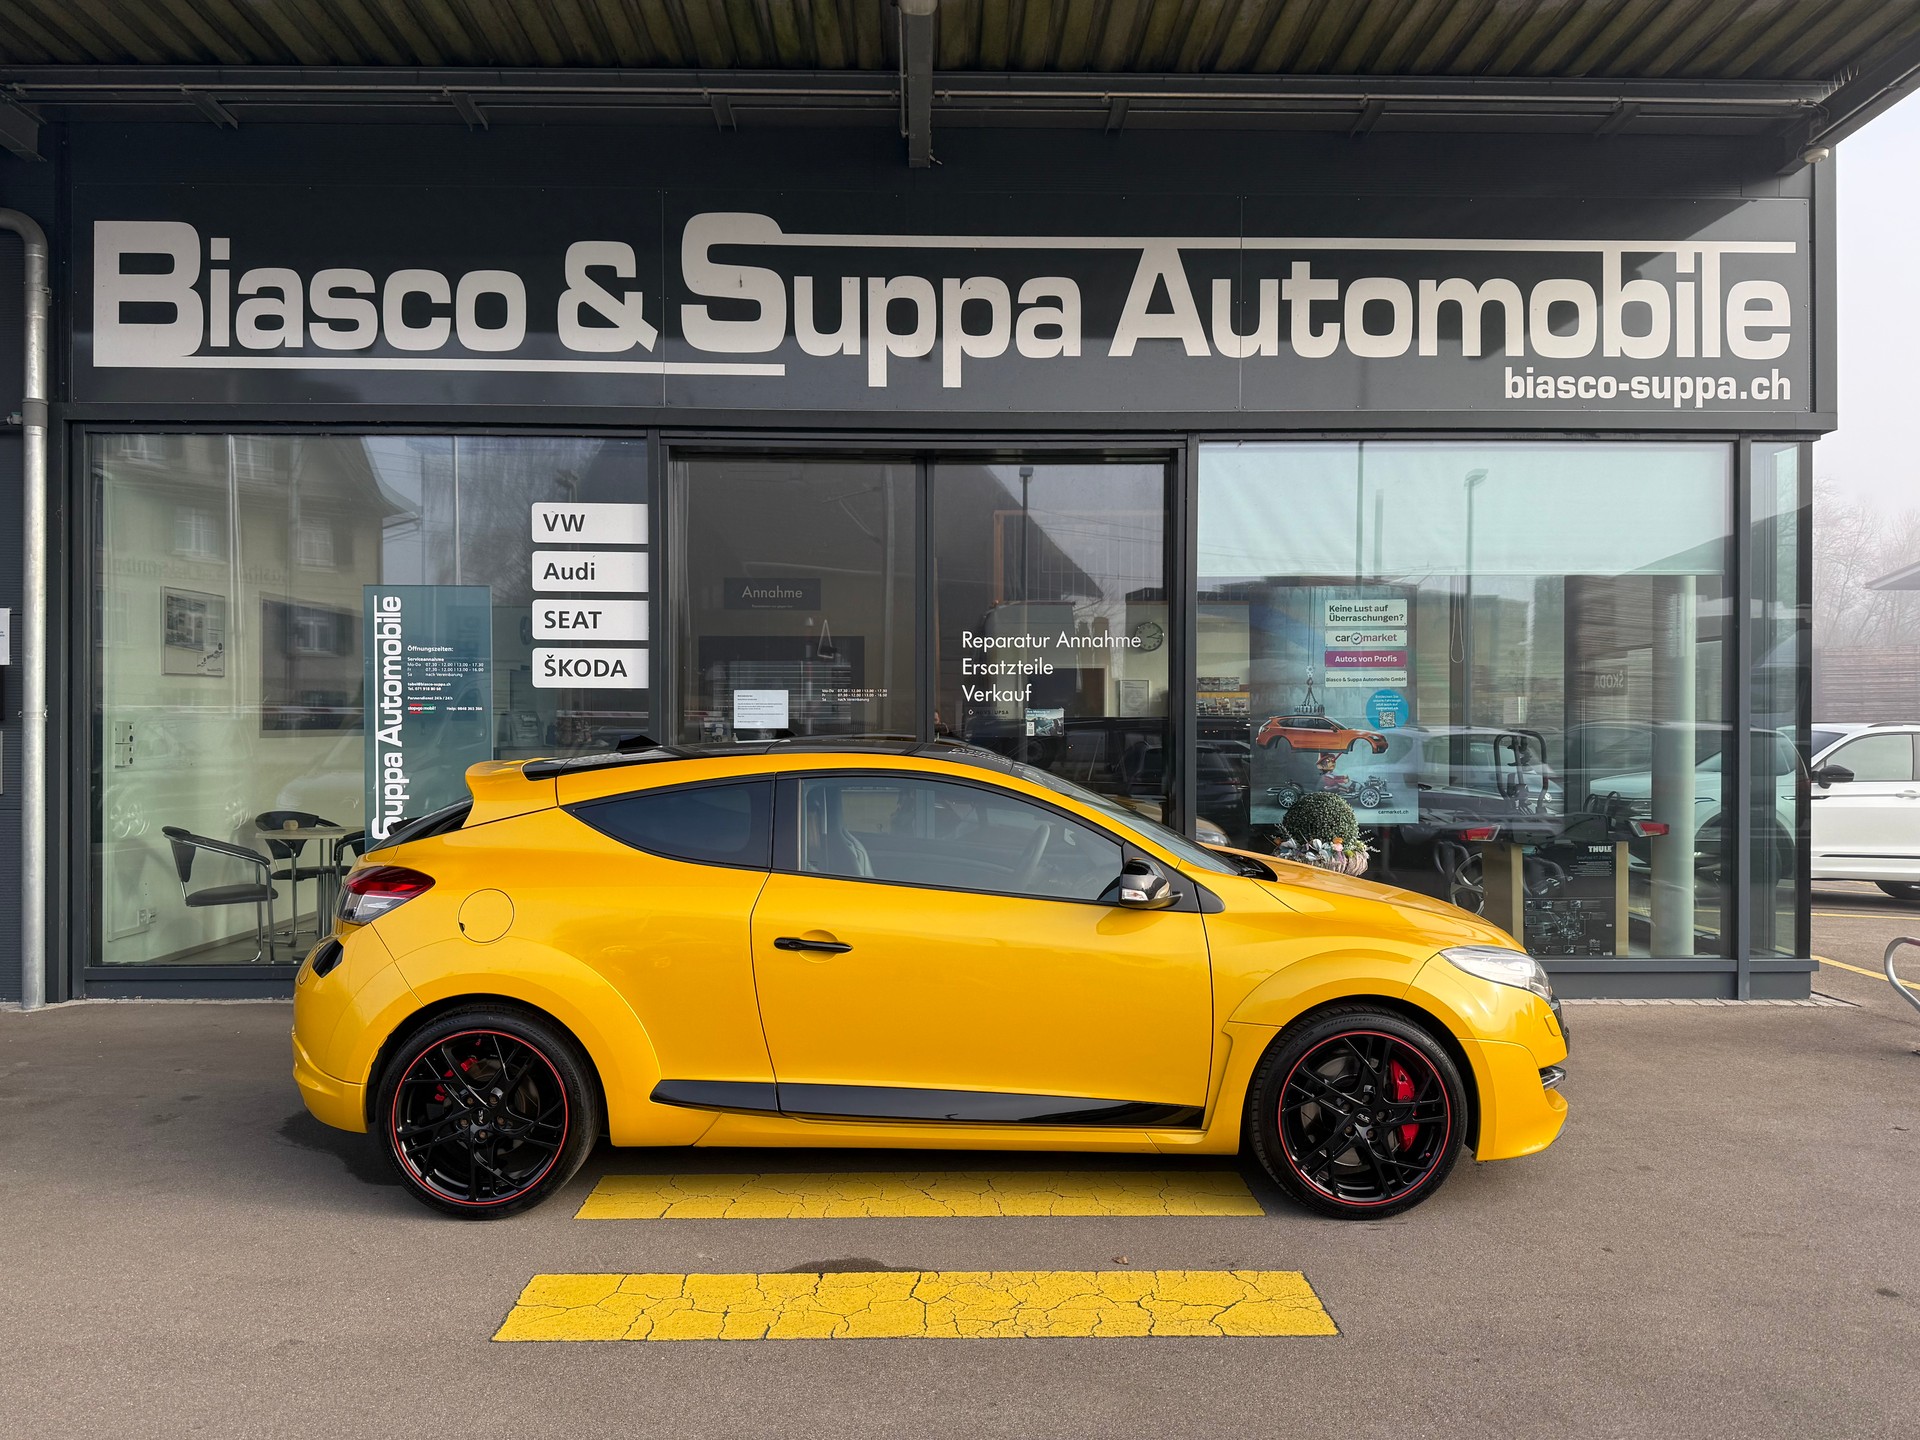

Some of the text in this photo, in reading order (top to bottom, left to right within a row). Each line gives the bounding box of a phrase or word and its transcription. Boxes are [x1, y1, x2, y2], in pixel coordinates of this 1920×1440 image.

[93, 212, 1793, 388] Biasco & Suppa Automobile
[1503, 366, 1792, 409] biasco-suppa.ch
[542, 513, 586, 533] VW
[543, 561, 596, 581] Audi
[741, 585, 803, 599] Annahme
[1328, 604, 1389, 613] Keine Lust auf
[1328, 612, 1405, 623] Überraschungen?
[543, 610, 603, 630] SEAT
[961, 629, 1142, 653] Reparatur Annahme
[1335, 633, 1398, 642] car market
[407, 645, 454, 653] Öffnungszeiten:
[1334, 654, 1398, 663] Autos von Profis
[374, 596, 403, 748] Automobile
[543, 653, 628, 678] ŠKODA
[961, 657, 1054, 676] Ersatzteile
[961, 684, 1033, 702] Verkauf
[1587, 845, 1612, 853] THULE
